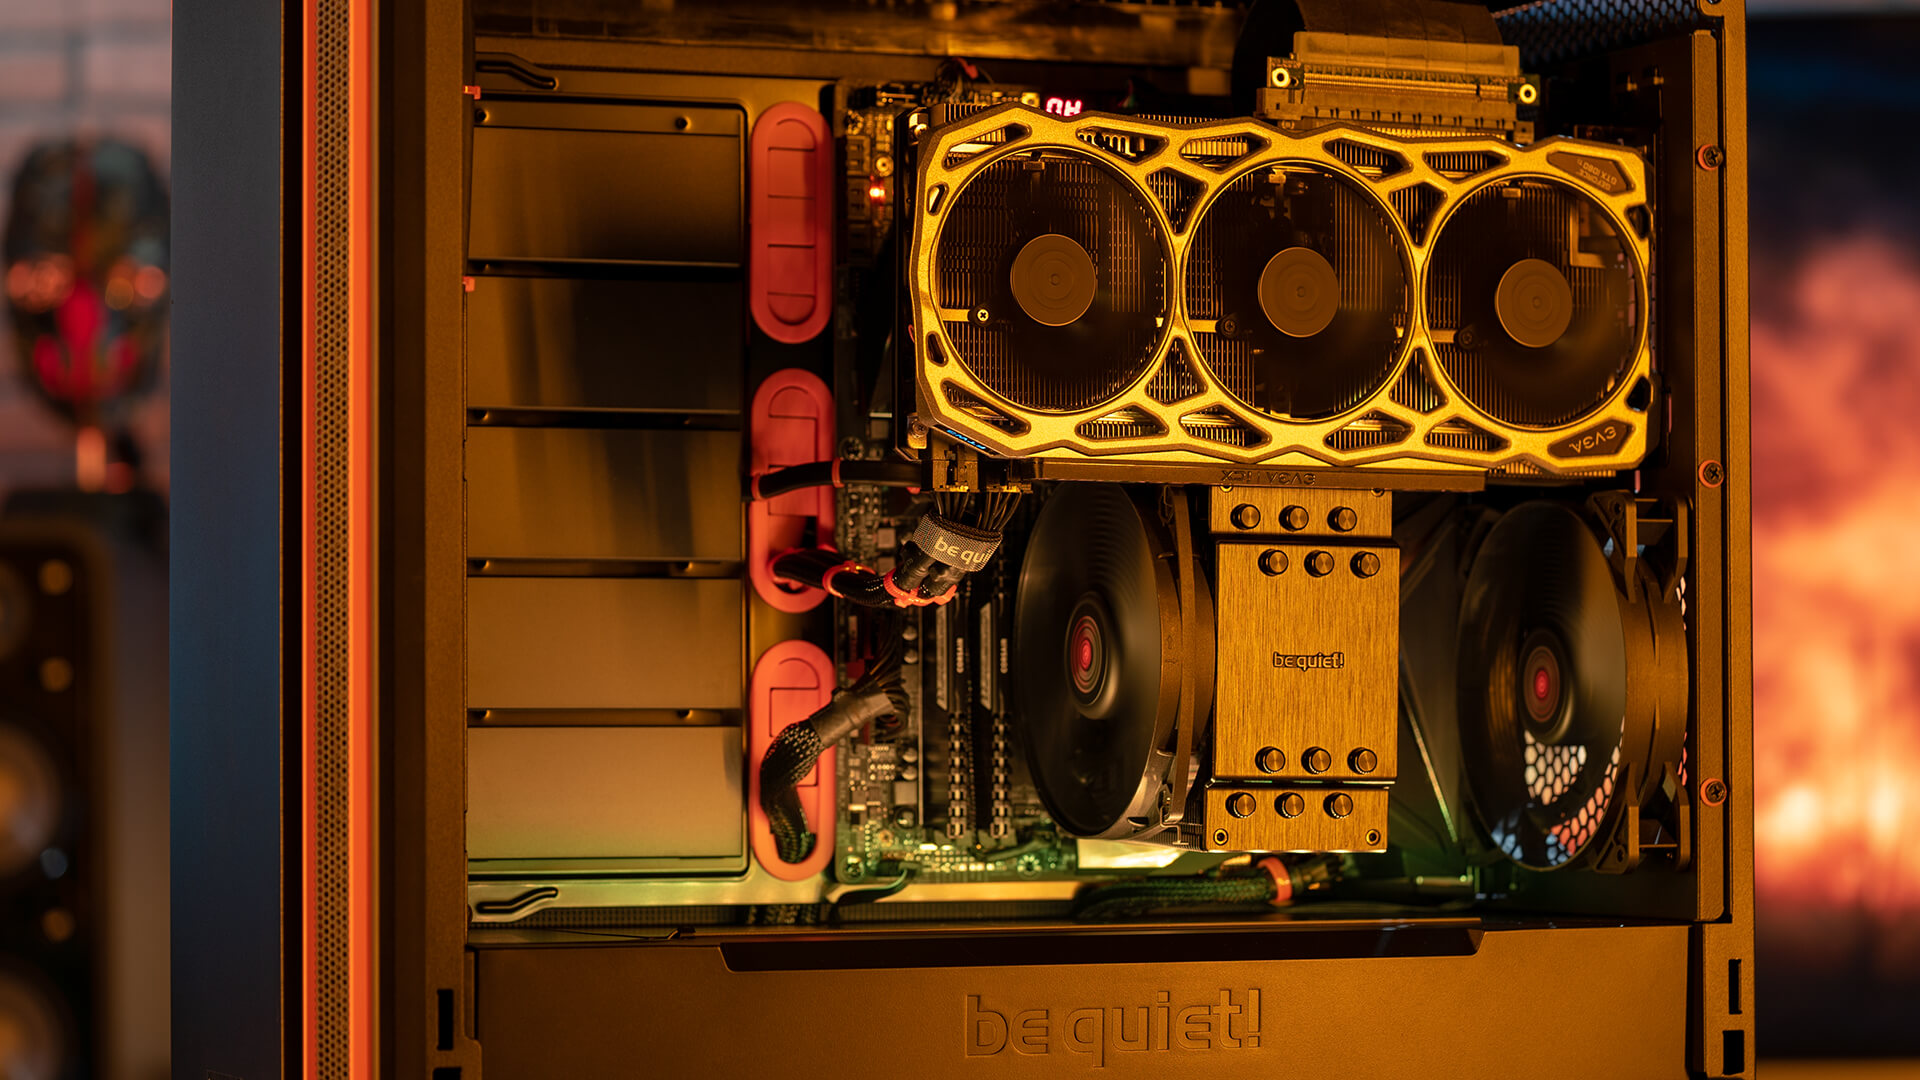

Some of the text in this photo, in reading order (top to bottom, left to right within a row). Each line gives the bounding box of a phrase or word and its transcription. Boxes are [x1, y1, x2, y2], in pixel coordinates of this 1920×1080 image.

[934, 535, 960, 557] be
[1273, 651, 1345, 672] be quiet!
[965, 988, 1261, 1069] be quiet!
